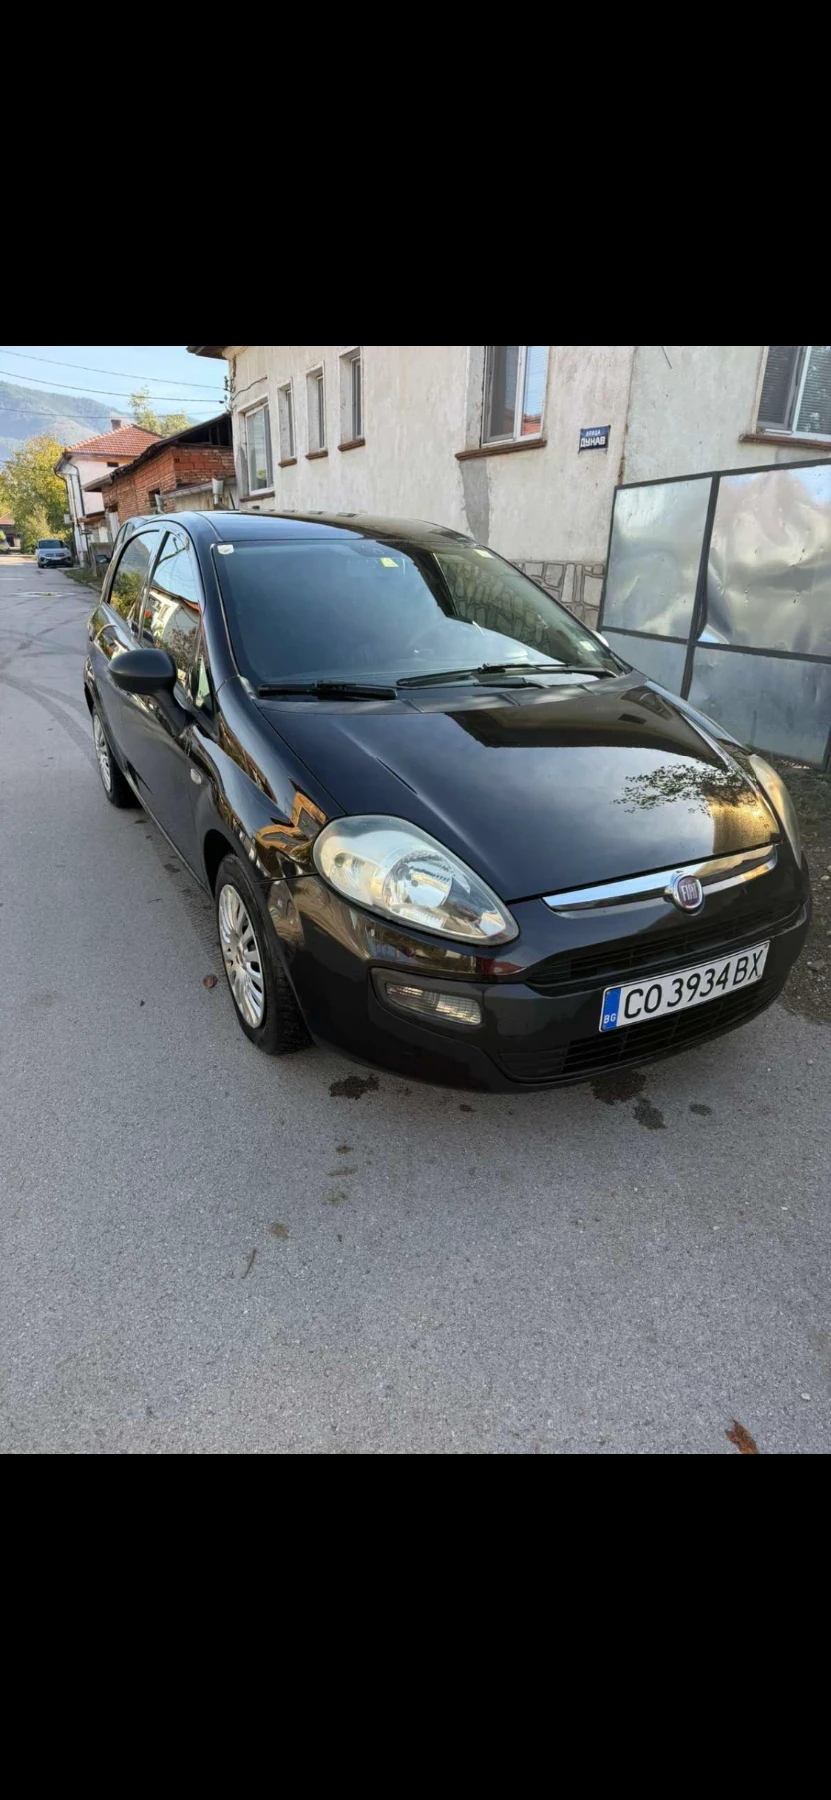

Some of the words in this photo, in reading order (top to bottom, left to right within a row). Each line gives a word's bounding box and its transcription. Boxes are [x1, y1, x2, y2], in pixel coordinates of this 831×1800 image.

[580, 436, 606, 448] ДУНАВ
[680, 883, 698, 902] FIAT
[667, 962, 731, 1008] 3934
[733, 950, 763, 986] BX
[603, 1013, 616, 1024] BG
